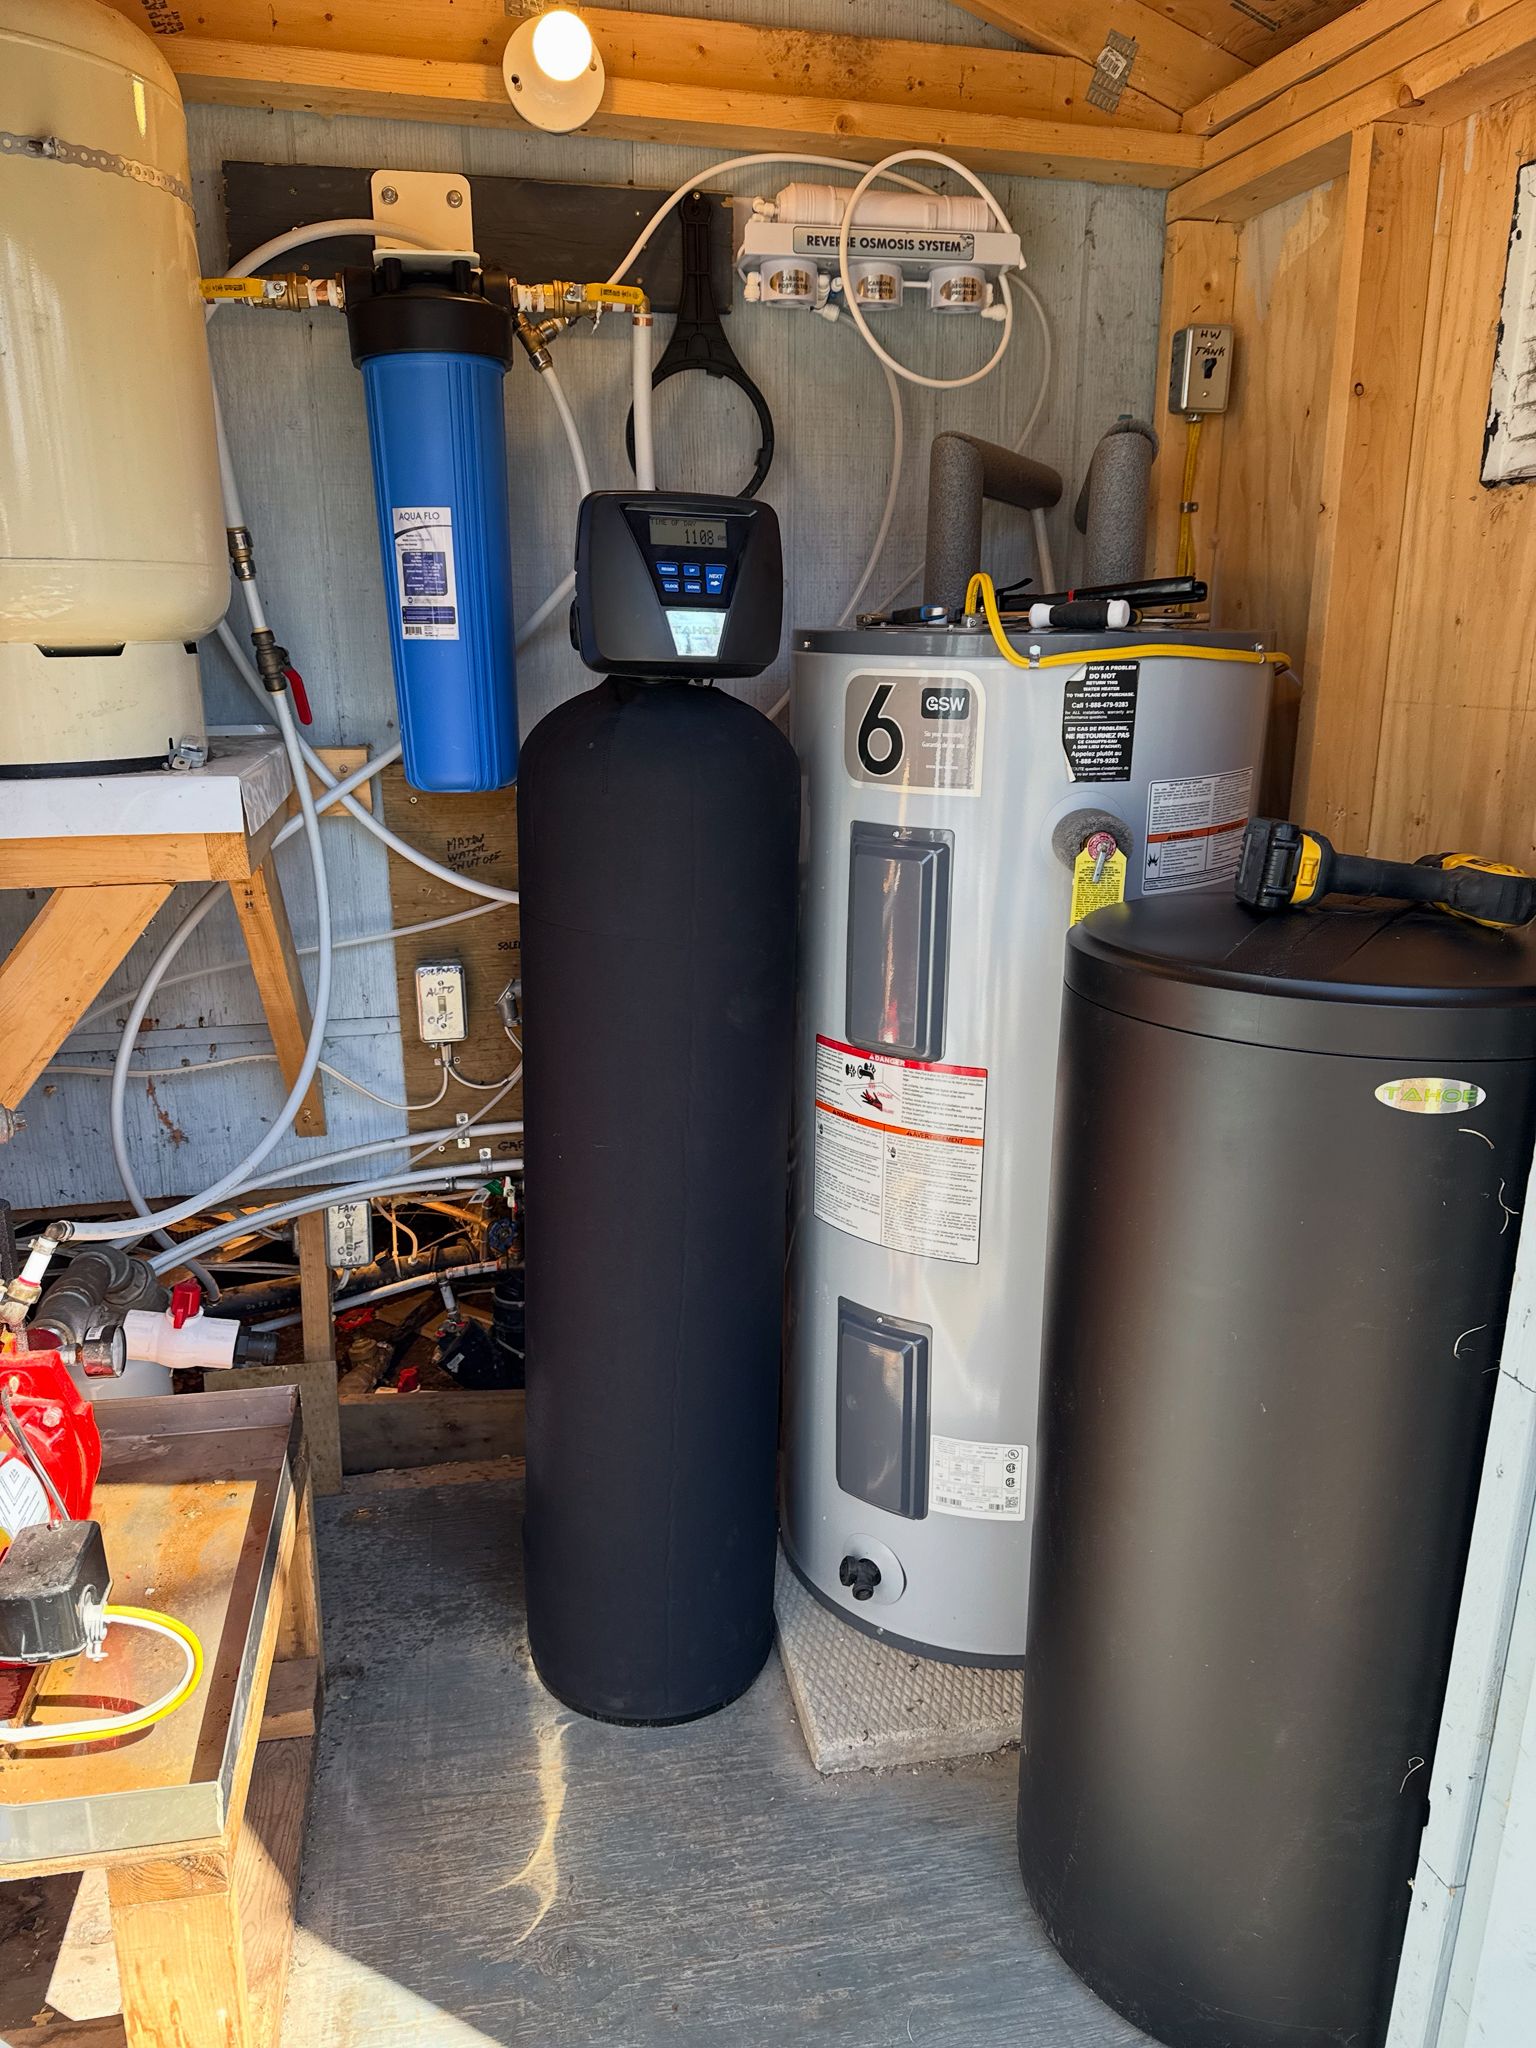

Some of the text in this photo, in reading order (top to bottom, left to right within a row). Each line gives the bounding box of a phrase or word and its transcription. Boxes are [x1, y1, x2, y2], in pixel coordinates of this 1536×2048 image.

[860, 238, 914, 250] OSMOSIS
[918, 240, 961, 252] SYSTEM
[1201, 330, 1221, 339] HW
[1195, 346, 1226, 356] TANK
[399, 512, 440, 521] AQUA FLO
[685, 529, 714, 545] 1108
[672, 626, 720, 635] TAHOE
[926, 696, 965, 711] GSW
[857, 682, 905, 778] 6
[447, 844, 488, 862] WATER
[483, 851, 502, 864] OFF
[498, 941, 520, 950] SOLE
[426, 985, 455, 997] AUTO
[428, 1012, 453, 1024] OFF
[874, 1055, 905, 1066] DANGER
[1384, 1086, 1478, 1104] TAHOE
[837, 1110, 859, 1123] WARNING
[912, 1131, 964, 1144] AVERTISSEMENT
[338, 1205, 358, 1214] FAN
[338, 1218, 354, 1229] ON
[338, 1240, 363, 1255] OFF
